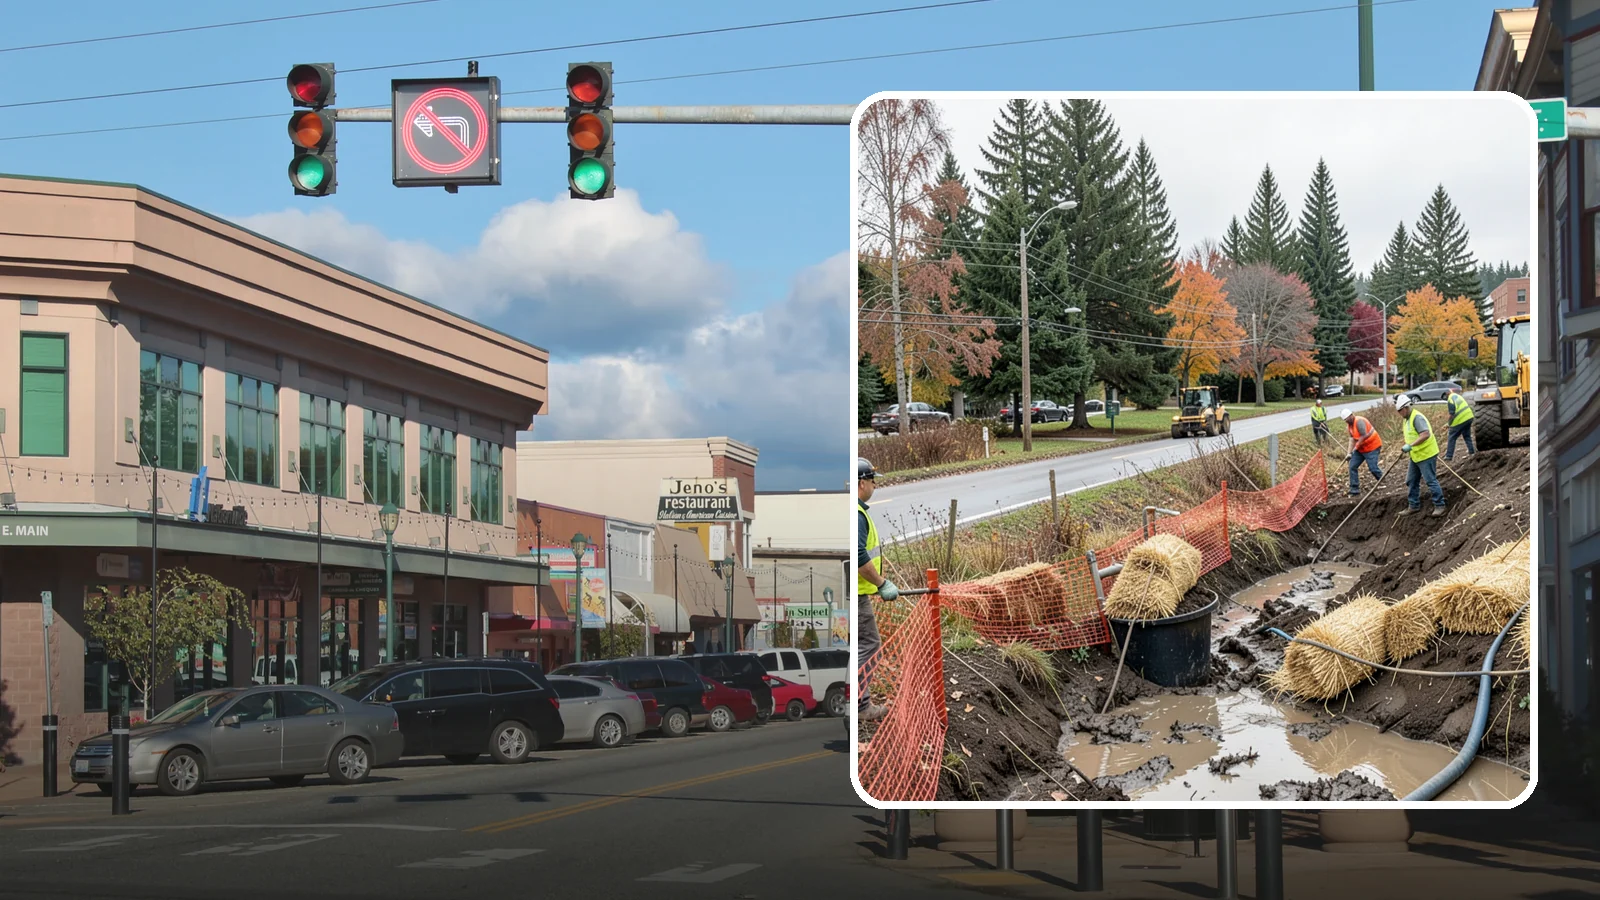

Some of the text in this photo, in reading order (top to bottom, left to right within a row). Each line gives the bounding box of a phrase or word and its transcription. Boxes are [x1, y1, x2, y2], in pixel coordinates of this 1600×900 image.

[670, 480, 727, 494] Jeno's
[665, 496, 730, 509] restaurant
[658, 510, 682, 520] Italian
[686, 510, 714, 519] American
[715, 510, 737, 519] Cuisine
[2, 525, 48, 536] E. MAIN
[798, 607, 828, 616] Street
